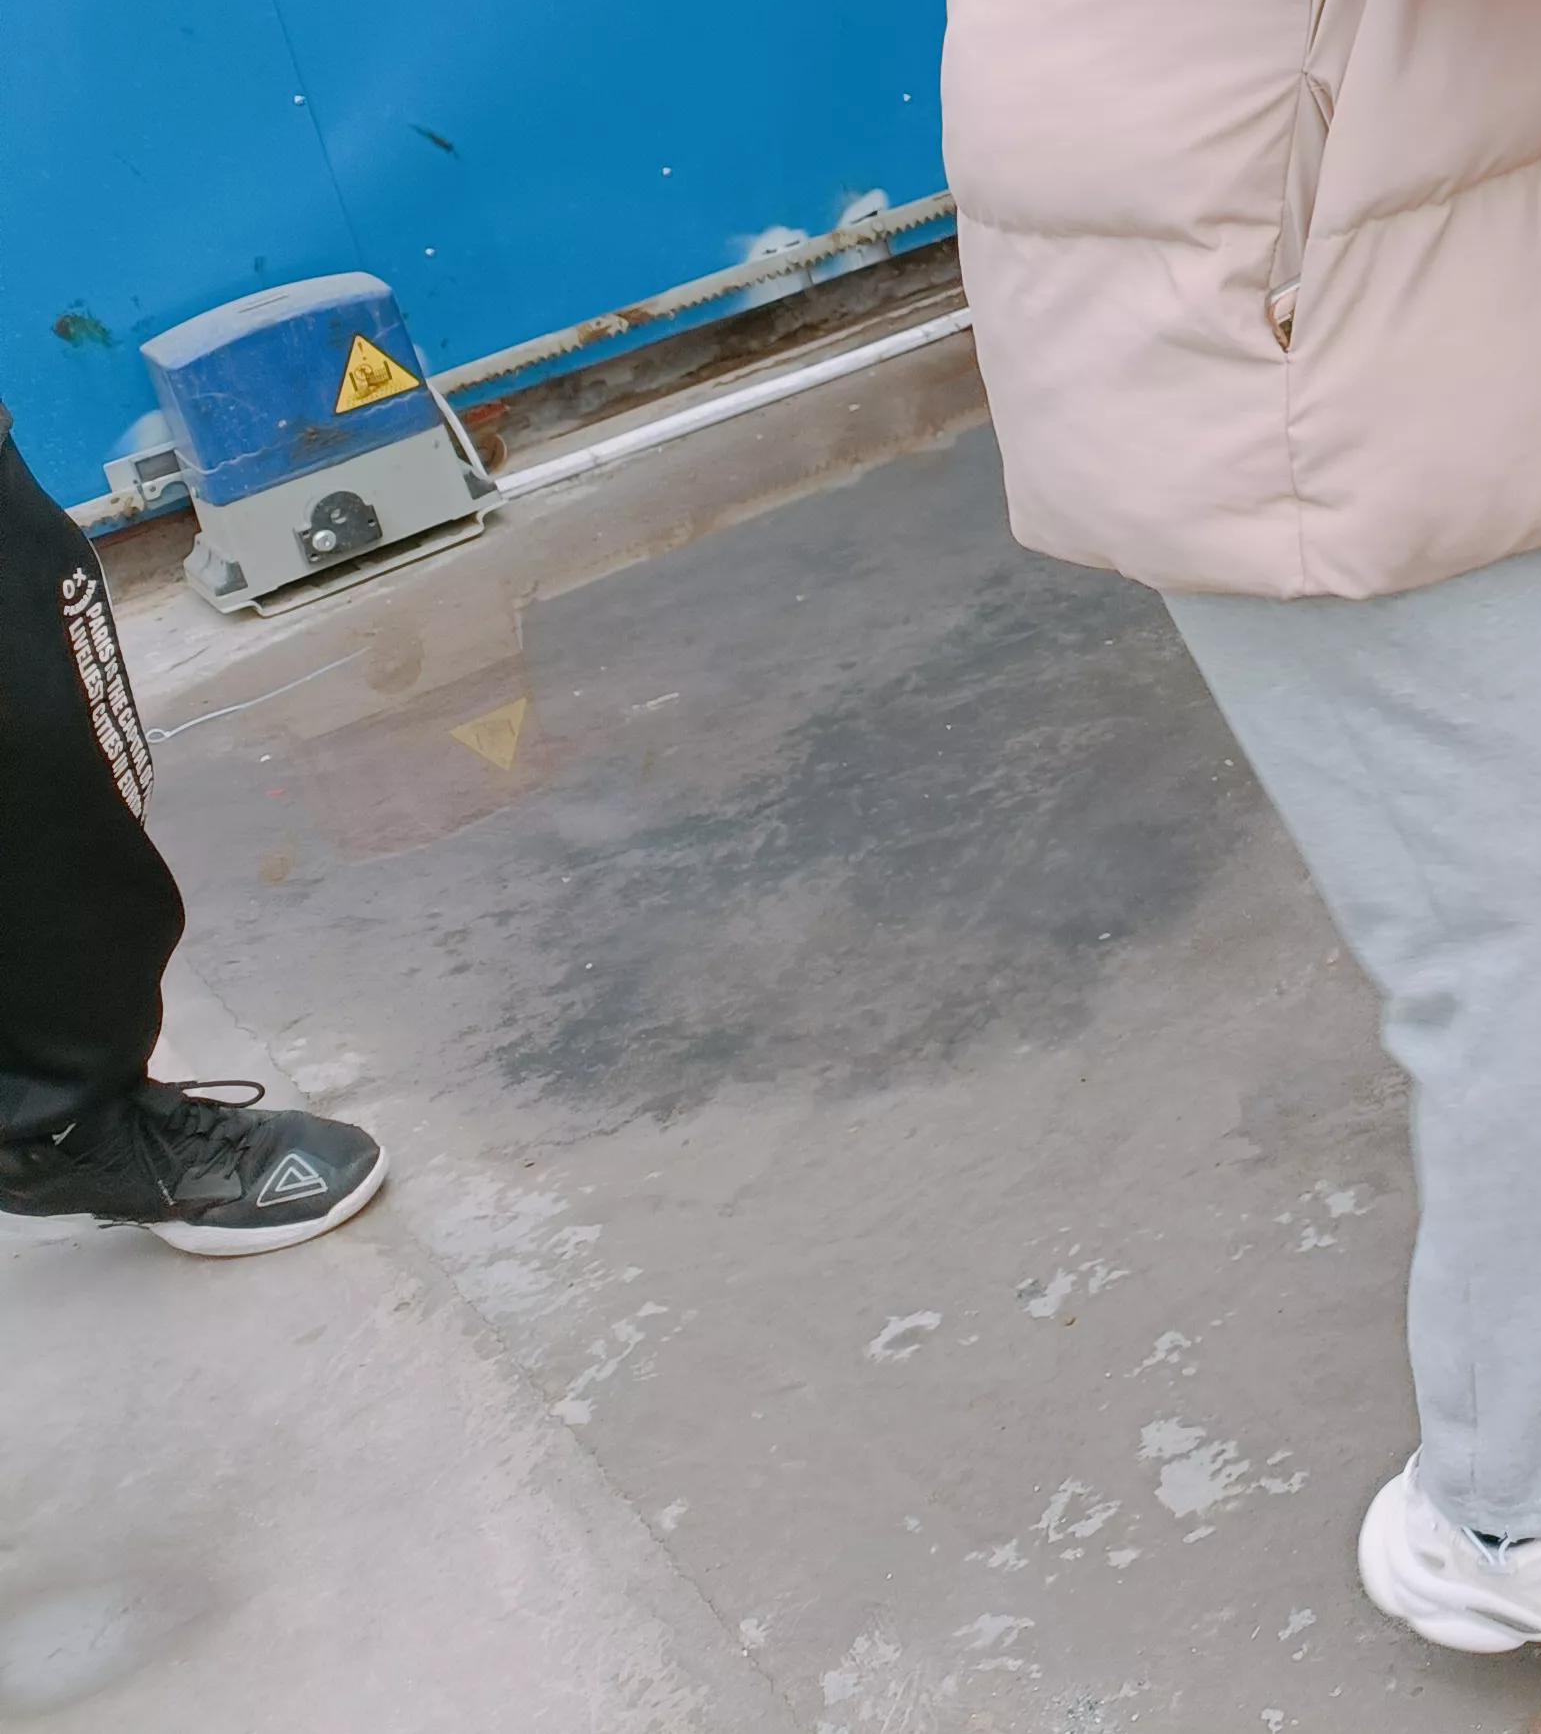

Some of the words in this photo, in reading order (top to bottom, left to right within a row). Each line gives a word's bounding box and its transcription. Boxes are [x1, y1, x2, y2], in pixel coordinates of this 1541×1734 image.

[69, 617, 104, 706] LIVELIEST
[92, 702, 123, 760] CITIES
[86, 602, 115, 662] PARIS
[107, 674, 129, 716] THE
